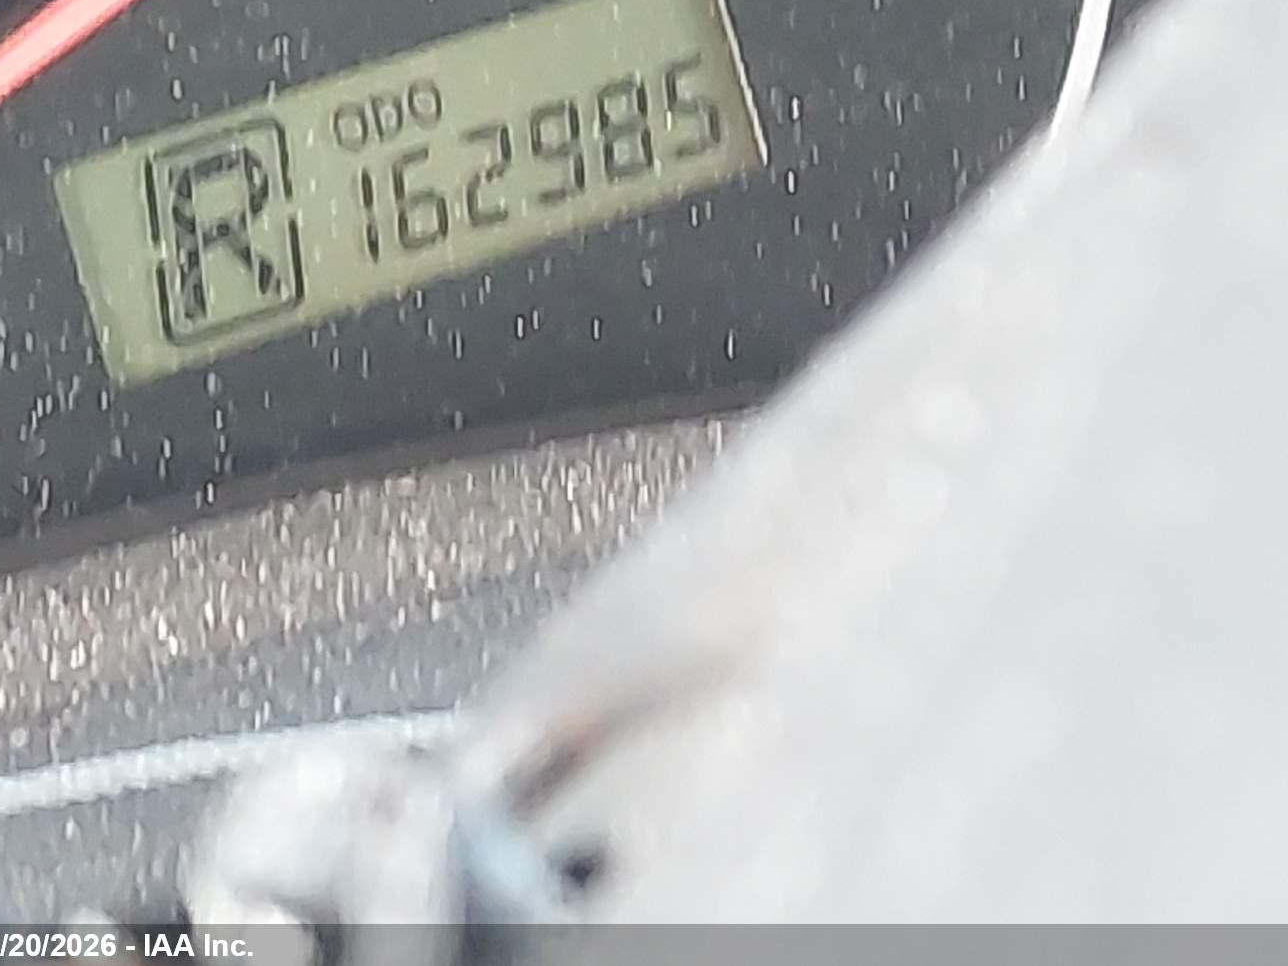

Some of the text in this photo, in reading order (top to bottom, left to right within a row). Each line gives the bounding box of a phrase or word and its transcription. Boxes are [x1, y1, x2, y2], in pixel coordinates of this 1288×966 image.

[331, 77, 443, 152] ODO
[360, 52, 722, 264] 162985
[168, 144, 284, 322] R
